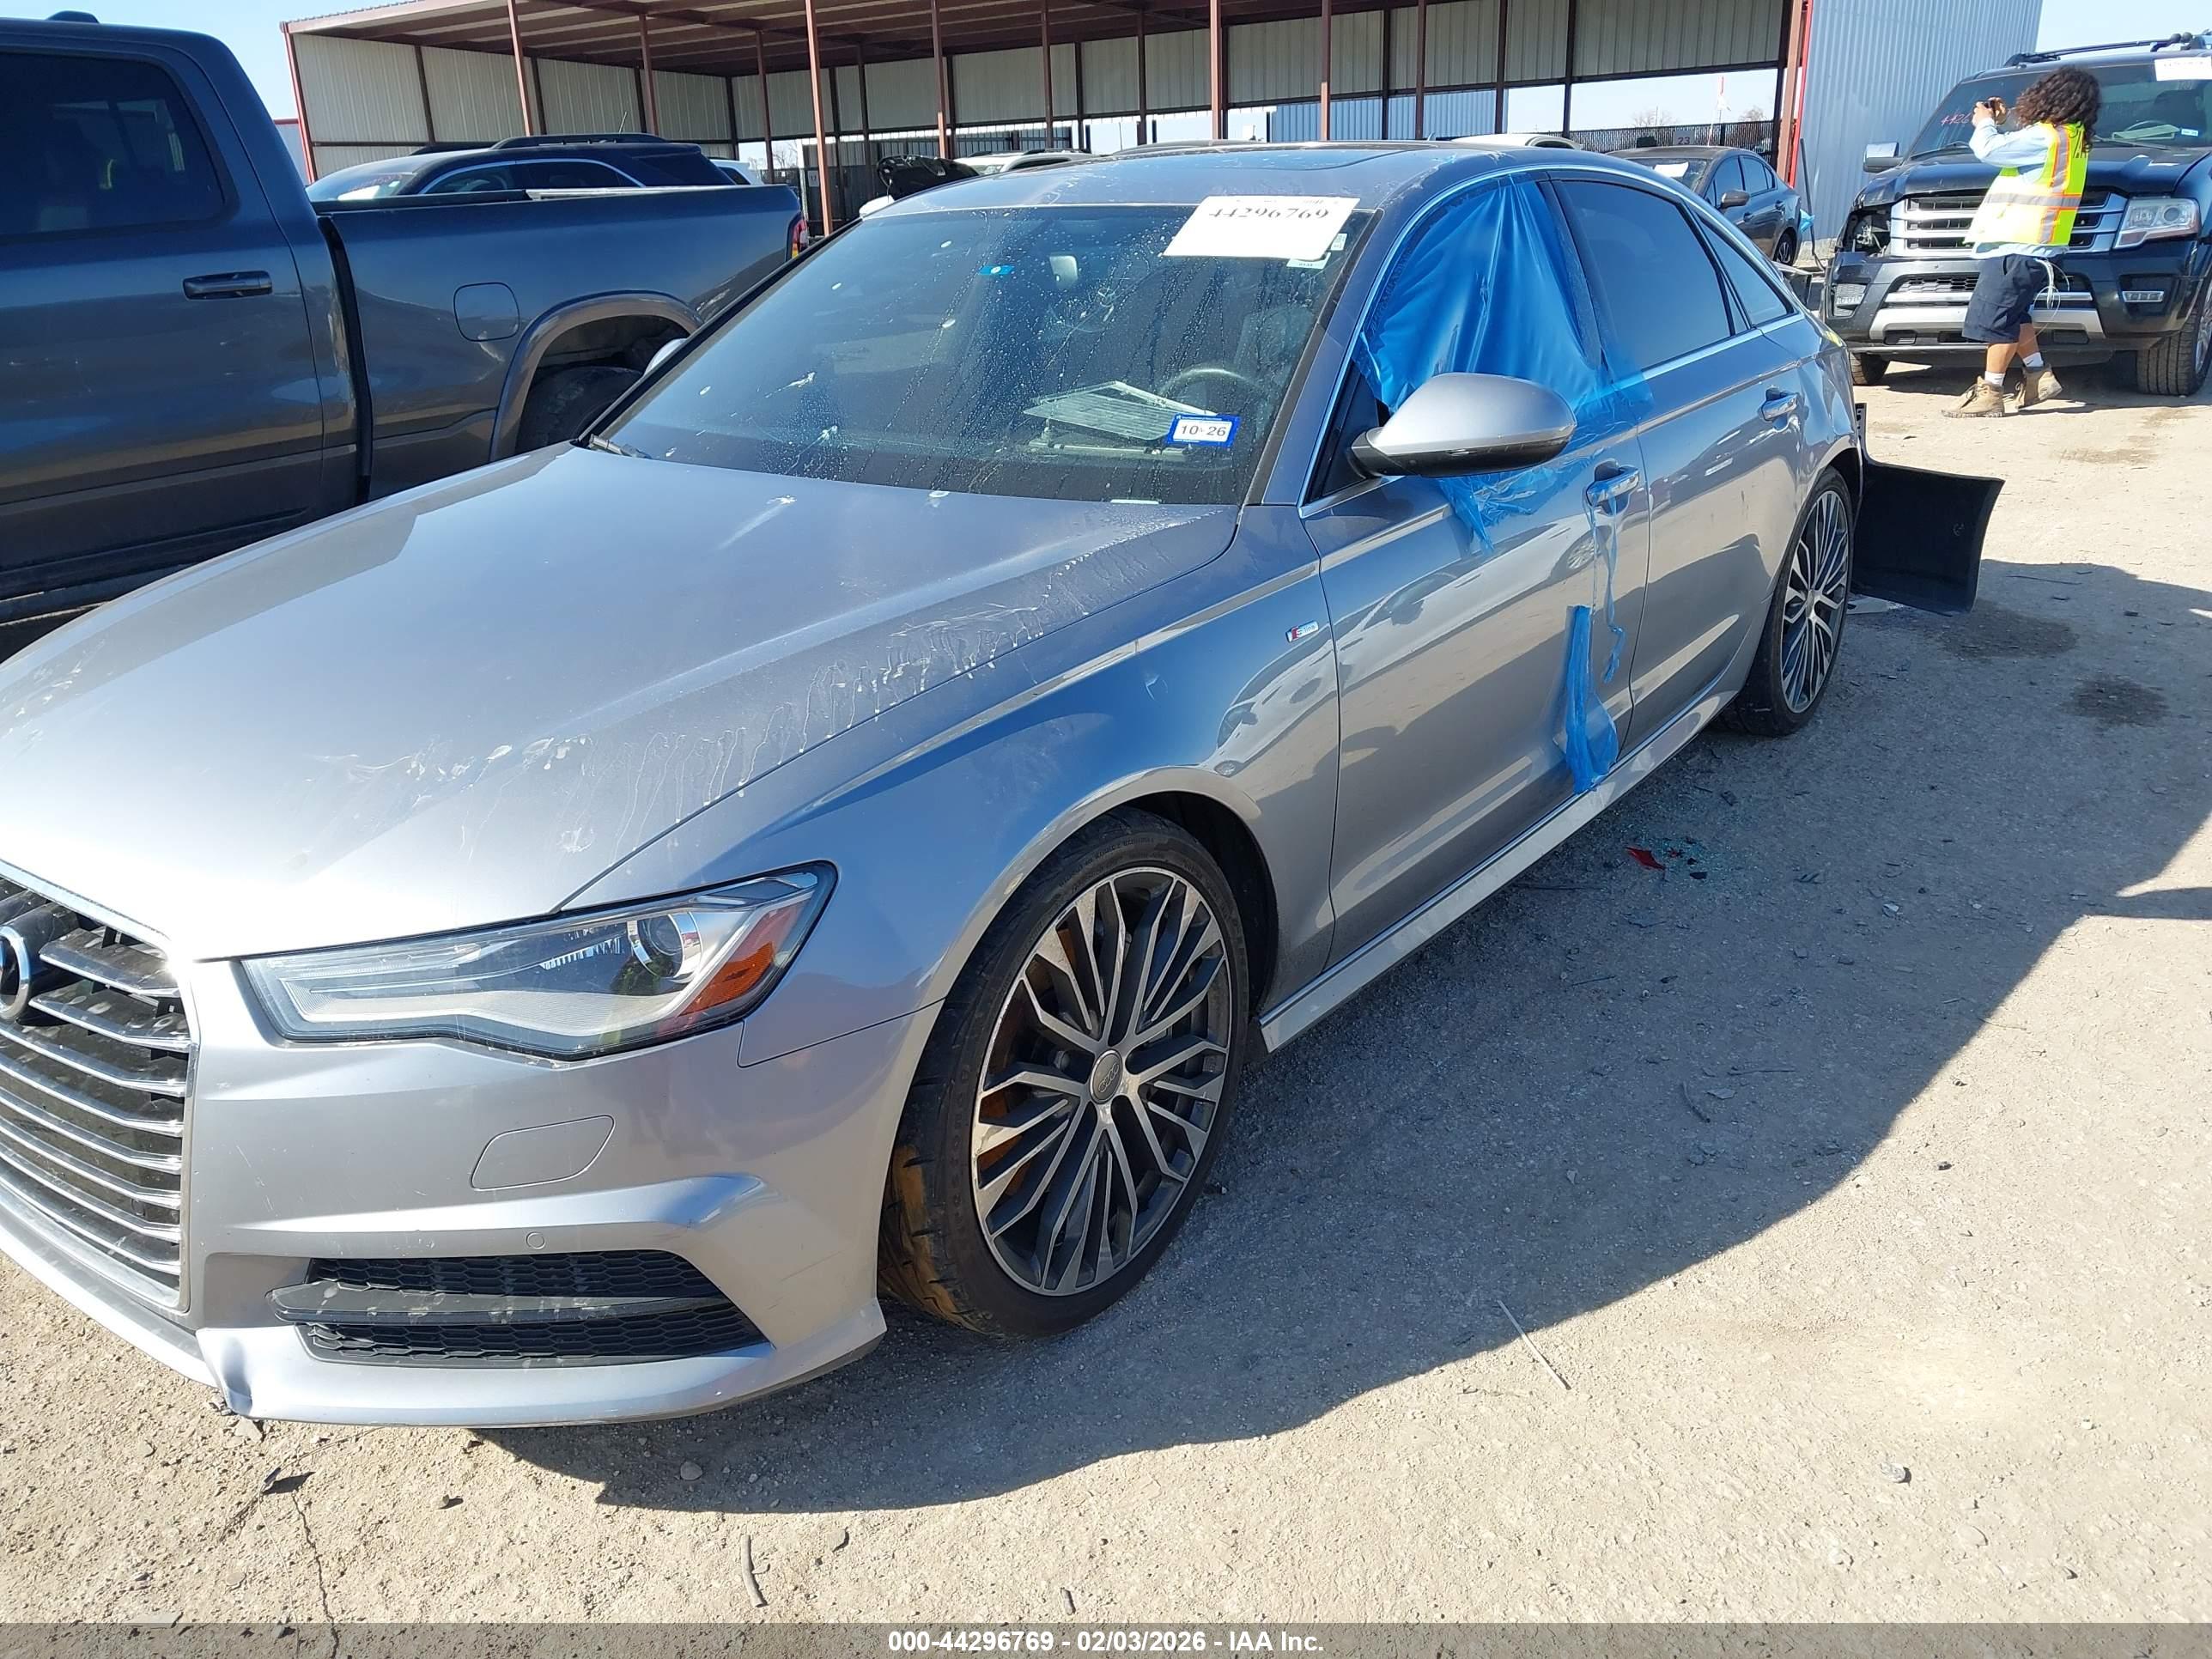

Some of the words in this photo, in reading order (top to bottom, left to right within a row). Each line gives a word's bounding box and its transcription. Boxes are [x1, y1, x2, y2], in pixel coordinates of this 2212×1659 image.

[1677, 137, 1690, 145] 23
[1208, 207, 1329, 219] 44296769
[1206, 426, 1227, 436] 26
